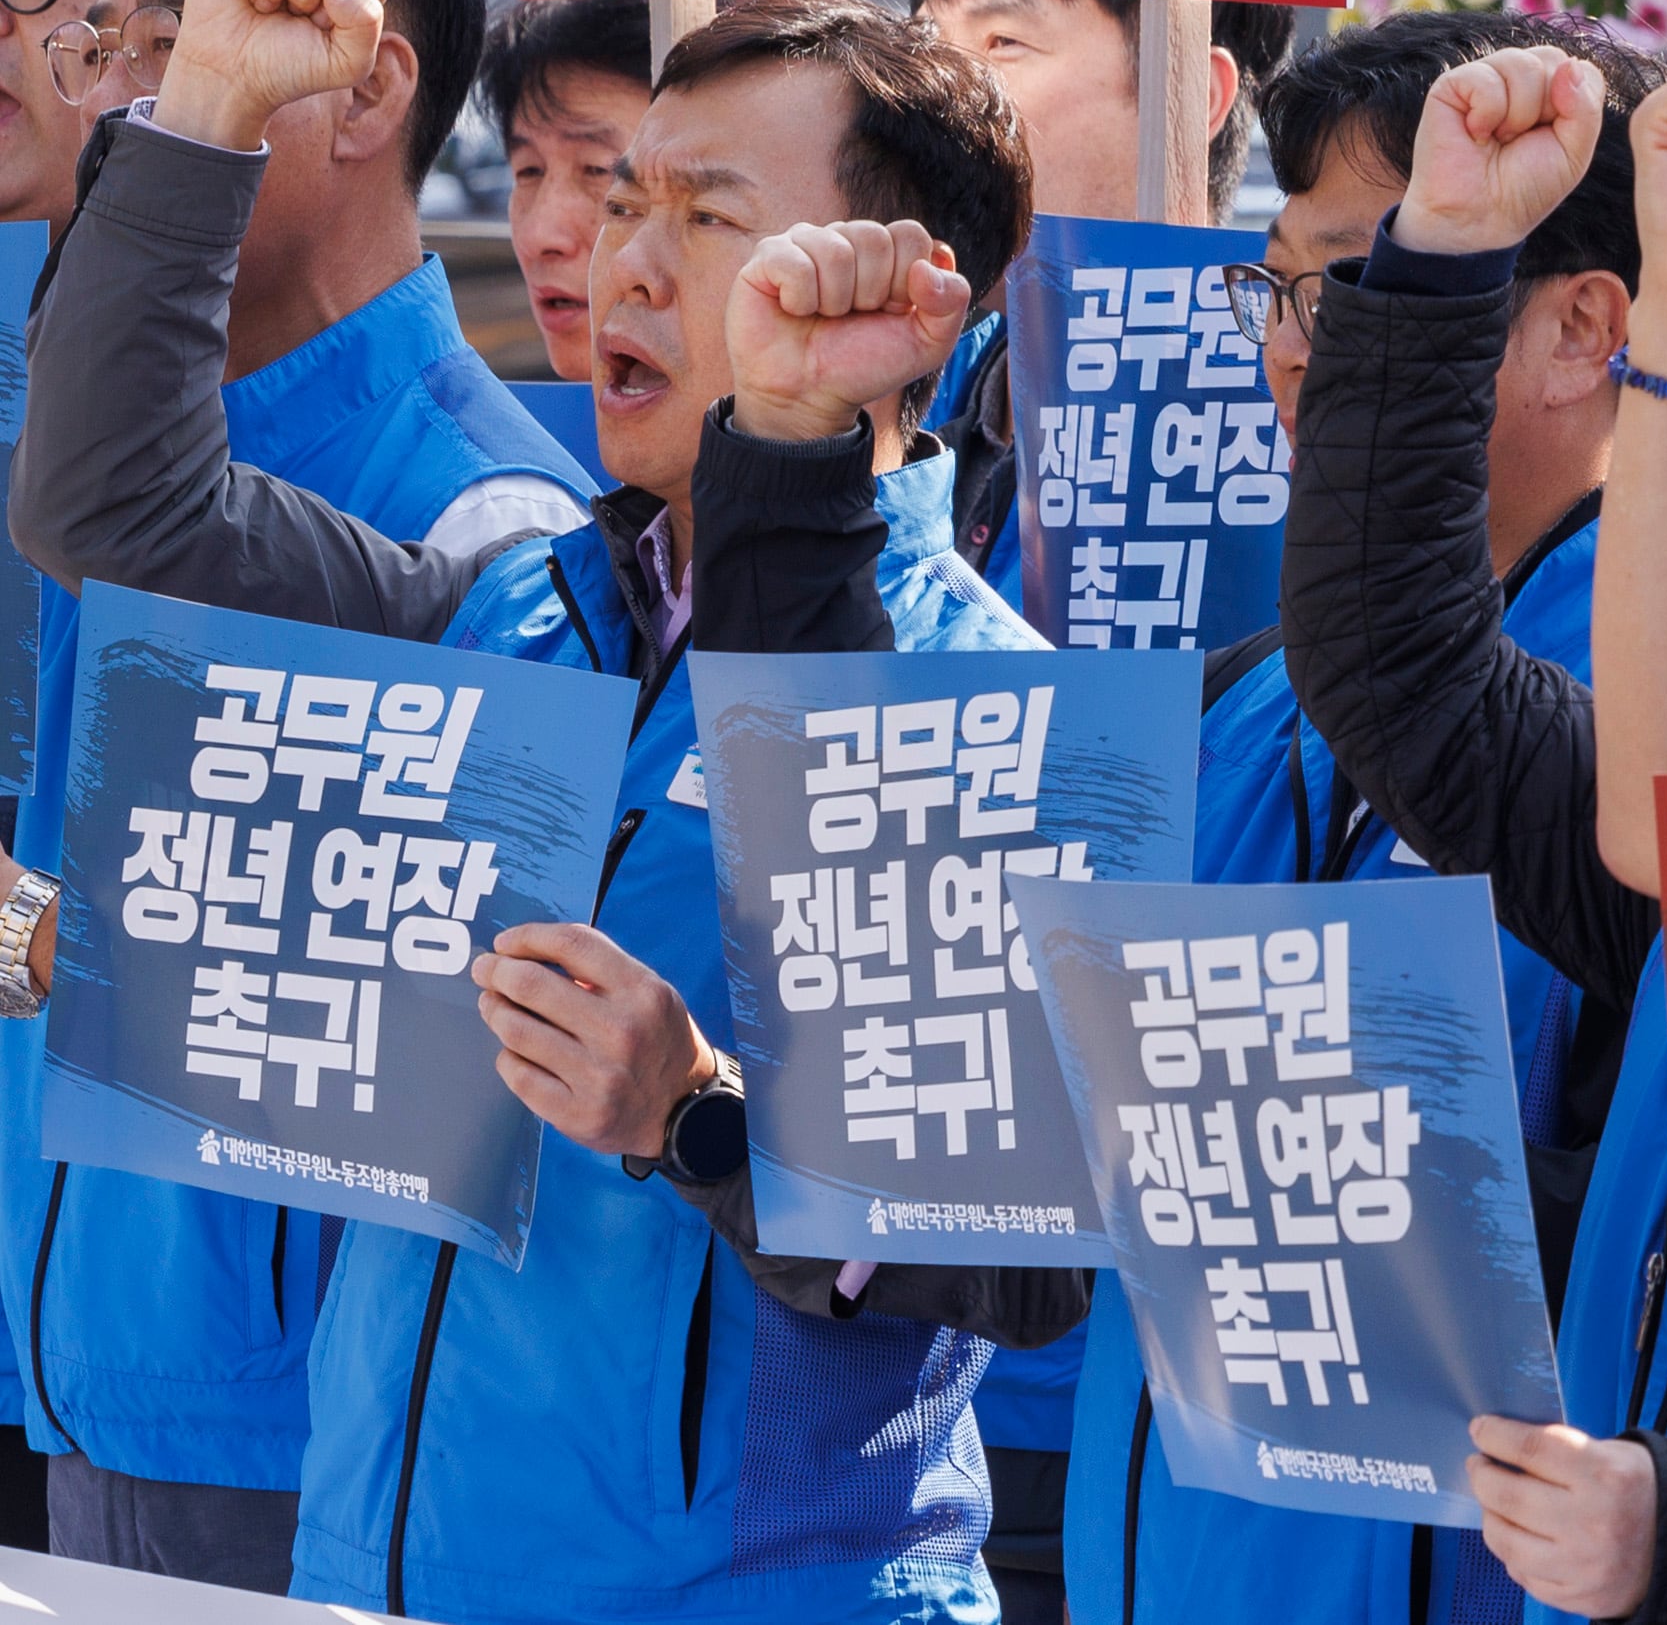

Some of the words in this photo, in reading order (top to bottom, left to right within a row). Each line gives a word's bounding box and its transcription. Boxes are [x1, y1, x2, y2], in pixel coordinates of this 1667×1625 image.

[1067, 267, 1258, 391] 공무원
[1038, 402, 1134, 528] 정년
[1147, 402, 1292, 526] 연장
[1068, 537, 1208, 650] 촉구!
[188, 665, 484, 822] 공무원
[805, 686, 1055, 853] 공무원
[122, 807, 293, 954] 정년
[307, 828, 499, 975] 연장
[770, 861, 911, 1011] 정년
[186, 963, 384, 1112] 촉구!
[1122, 922, 1352, 1088] 공무원
[843, 1011, 1015, 1160] 촉구!
[223, 1137, 429, 1203] 대한민국공무원노동조합총연맹
[888, 1203, 1075, 1235] 대한민국공무원노동조합총연맹
[1118, 1099, 1258, 1246] 정년
[1257, 1086, 1420, 1245] 연장
[1205, 1258, 1369, 1406] 촉구!
